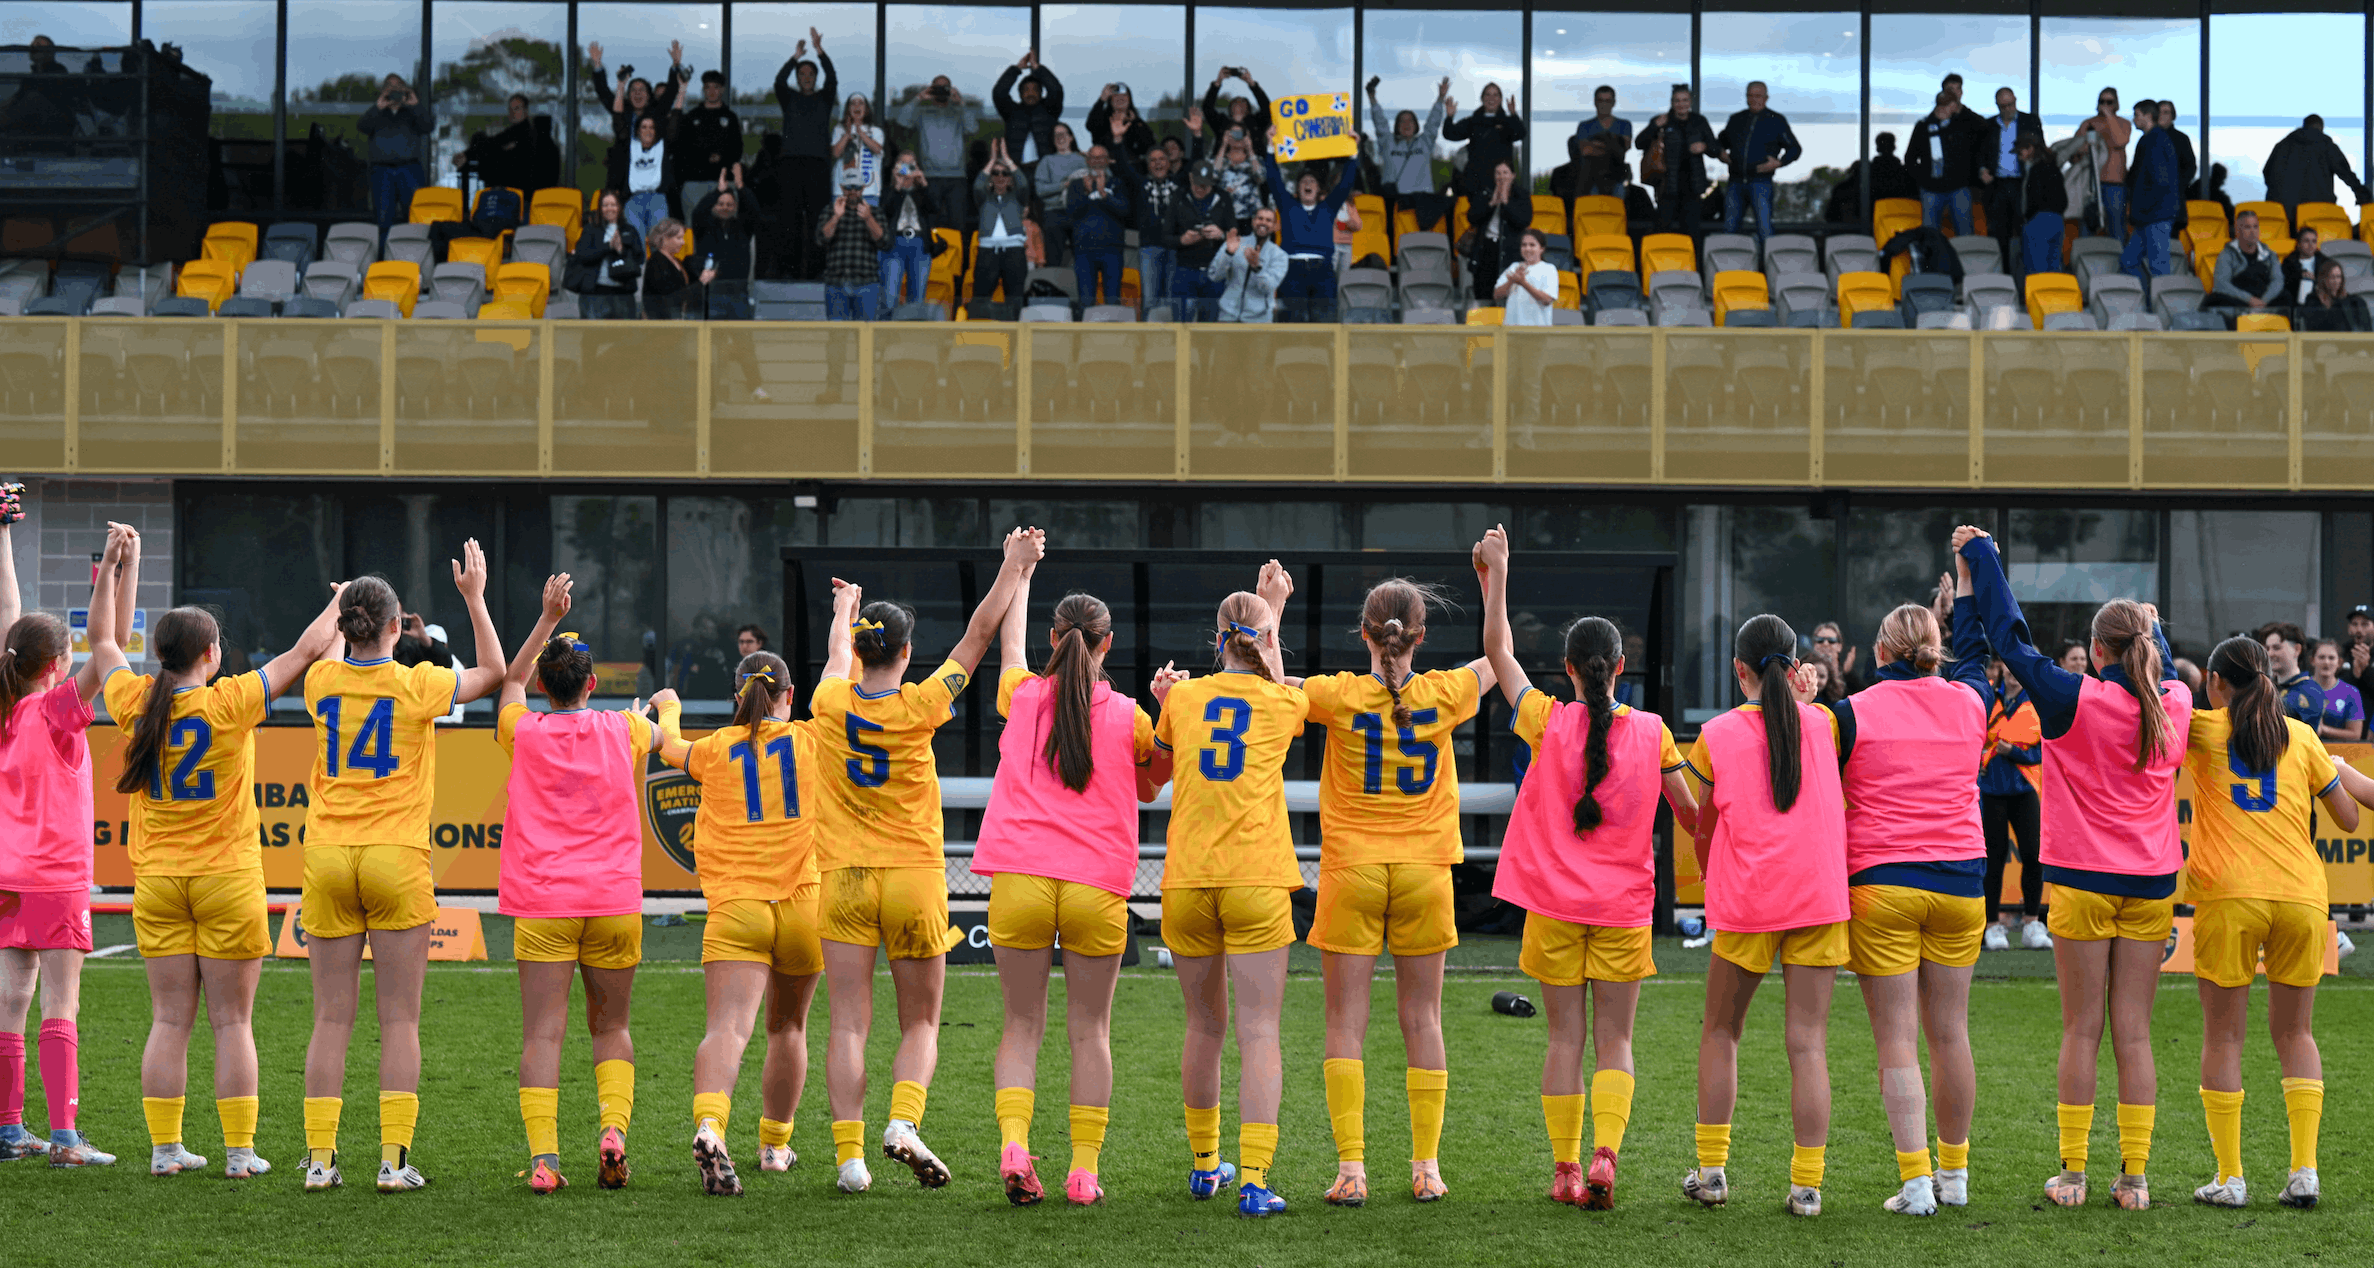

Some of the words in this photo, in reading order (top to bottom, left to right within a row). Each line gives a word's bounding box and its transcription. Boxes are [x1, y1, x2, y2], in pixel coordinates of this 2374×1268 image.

[1280, 98, 1309, 118] GO
[316, 696, 400, 779] 14
[729, 735, 800, 823] 11
[845, 711, 890, 787] 5
[1198, 695, 1253, 782] 3
[1351, 707, 1438, 795] 15
